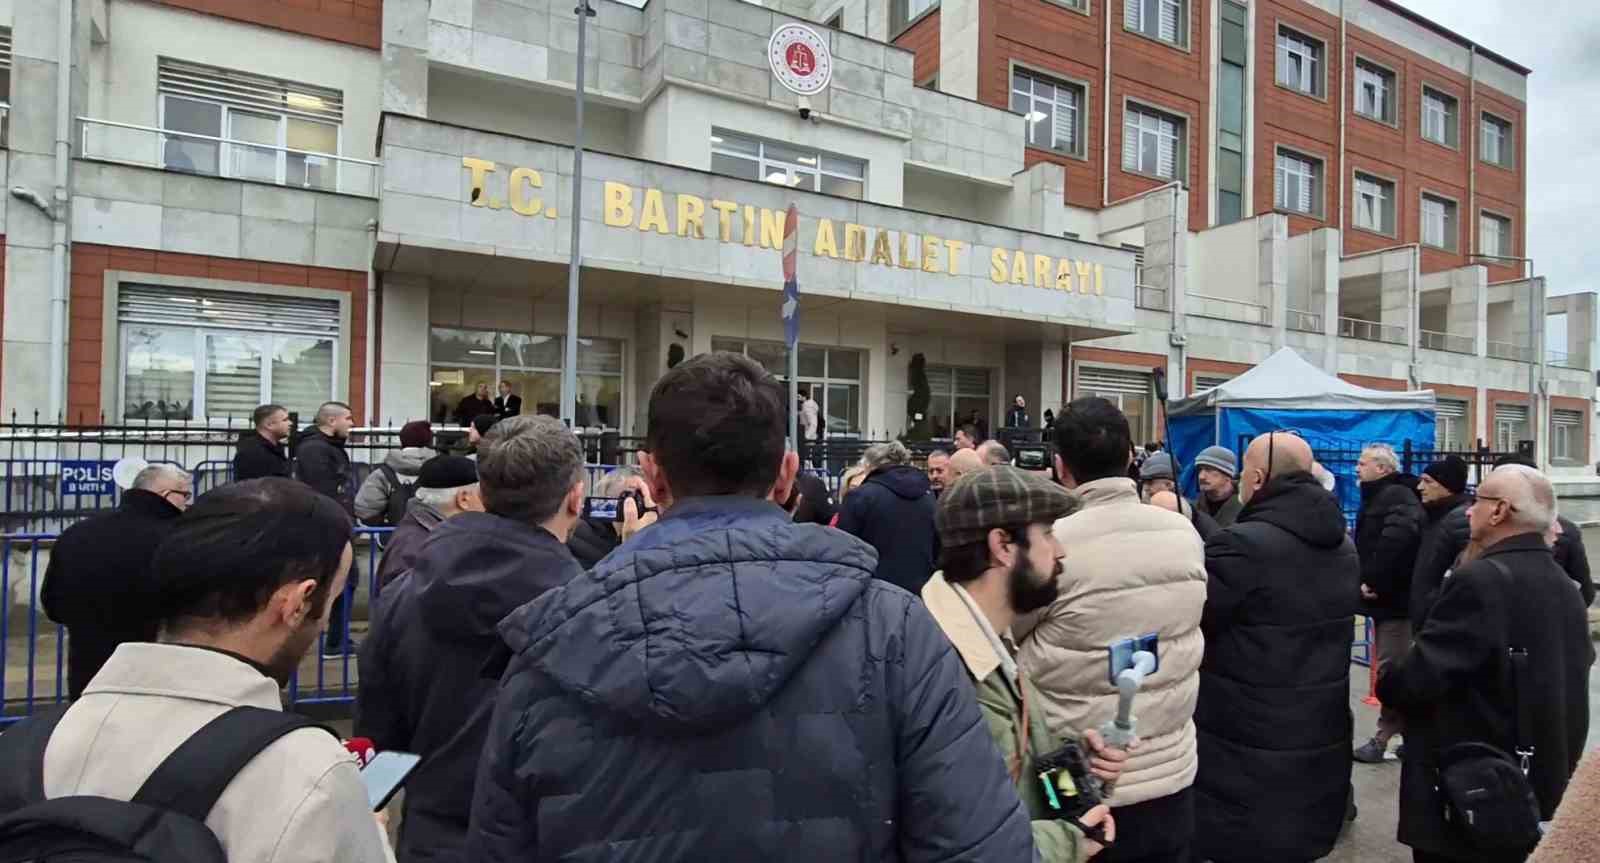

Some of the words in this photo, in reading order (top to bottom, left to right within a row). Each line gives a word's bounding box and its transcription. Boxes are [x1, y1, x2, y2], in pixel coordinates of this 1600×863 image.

[462, 156, 559, 219] T.C.
[604, 181, 785, 250] BARTIN
[812, 218, 965, 276] ADALET
[990, 247, 1104, 296] SARAYI
